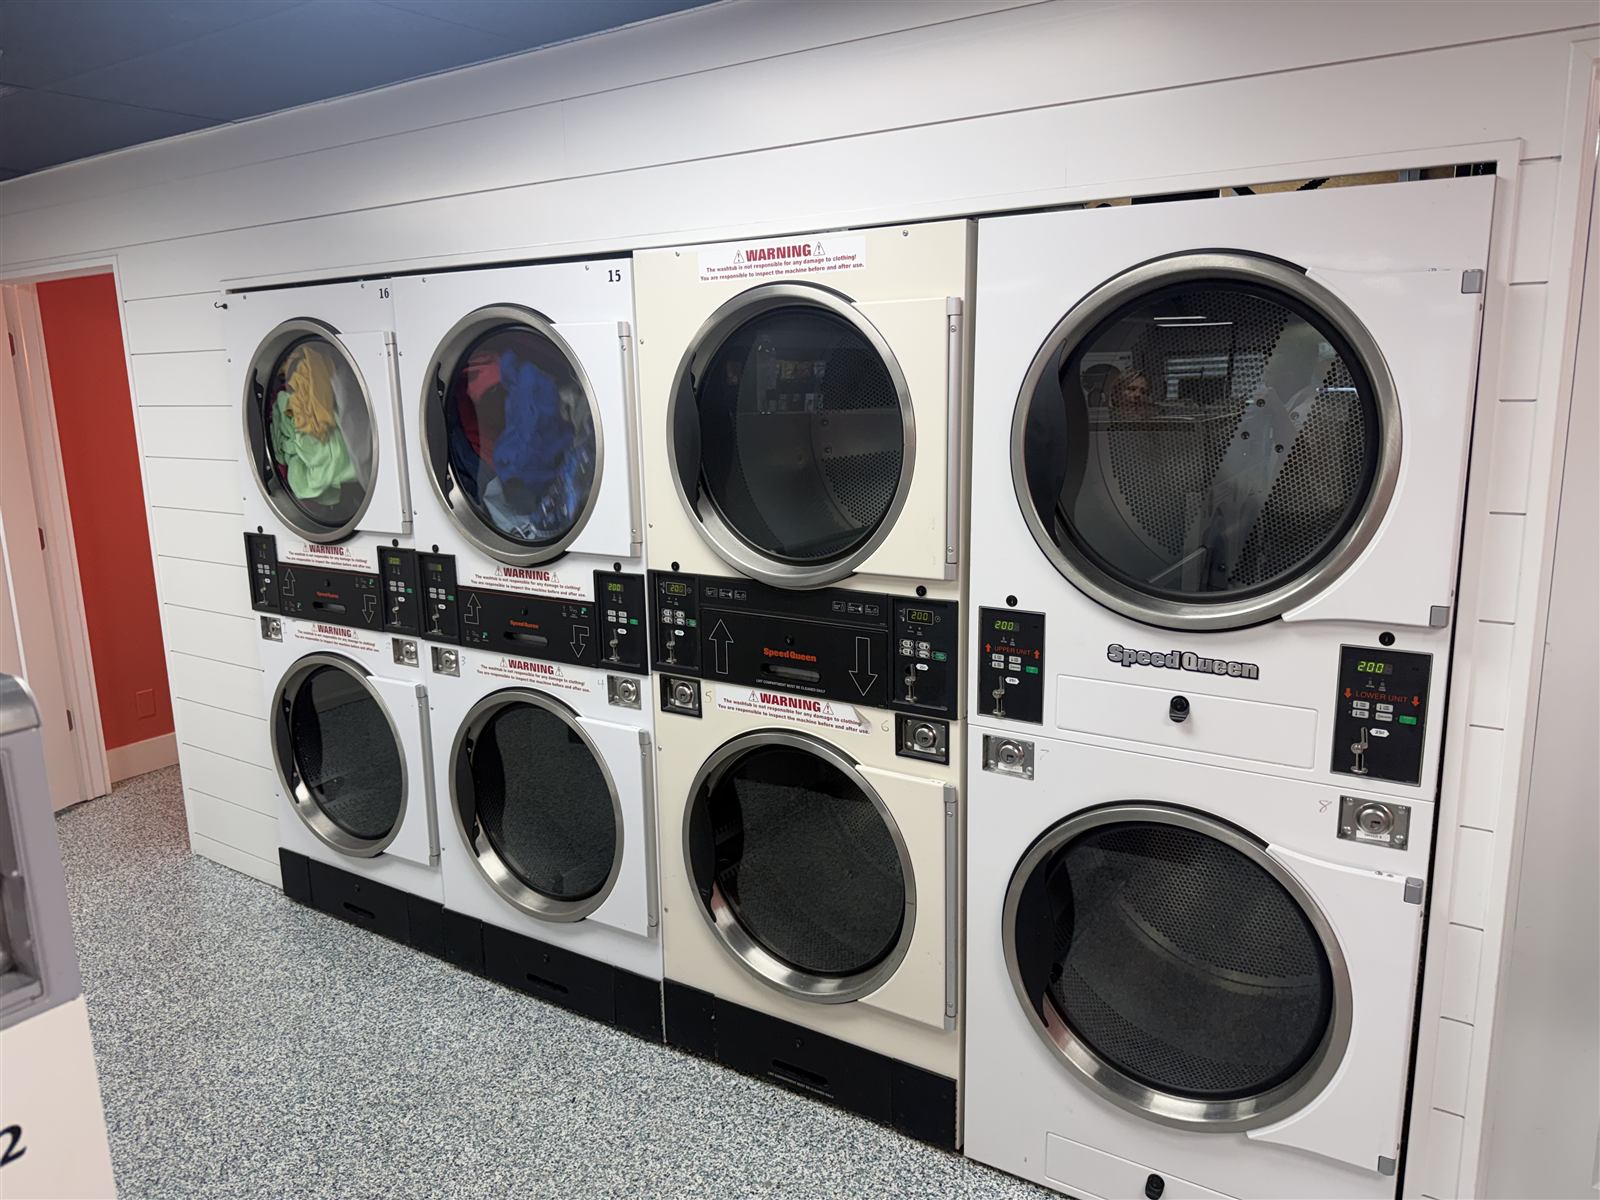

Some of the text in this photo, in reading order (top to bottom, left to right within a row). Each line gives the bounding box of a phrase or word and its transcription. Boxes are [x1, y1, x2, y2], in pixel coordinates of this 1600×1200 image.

[746, 244, 812, 262] WARNING
[754, 260, 783, 269] responsible
[608, 270, 621, 282] 15
[720, 272, 748, 280] responsible
[379, 288, 390, 300] 16
[309, 544, 344, 555] WARNING
[503, 568, 550, 581] WARNING
[608, 583, 621, 591] 200
[911, 611, 928, 621] 200
[318, 624, 351, 637] WARNING
[994, 620, 1014, 630] 200
[1016, 648, 1031, 656] UNIT
[508, 659, 554, 674] WARNING
[1357, 661, 1384, 673] 200
[704, 690, 712, 703] 5
[760, 692, 821, 712] WARNING
[1356, 691, 1408, 702] LOWER UNIT
[881, 720, 889, 732] 6
[1319, 800, 1332, 815] 8
